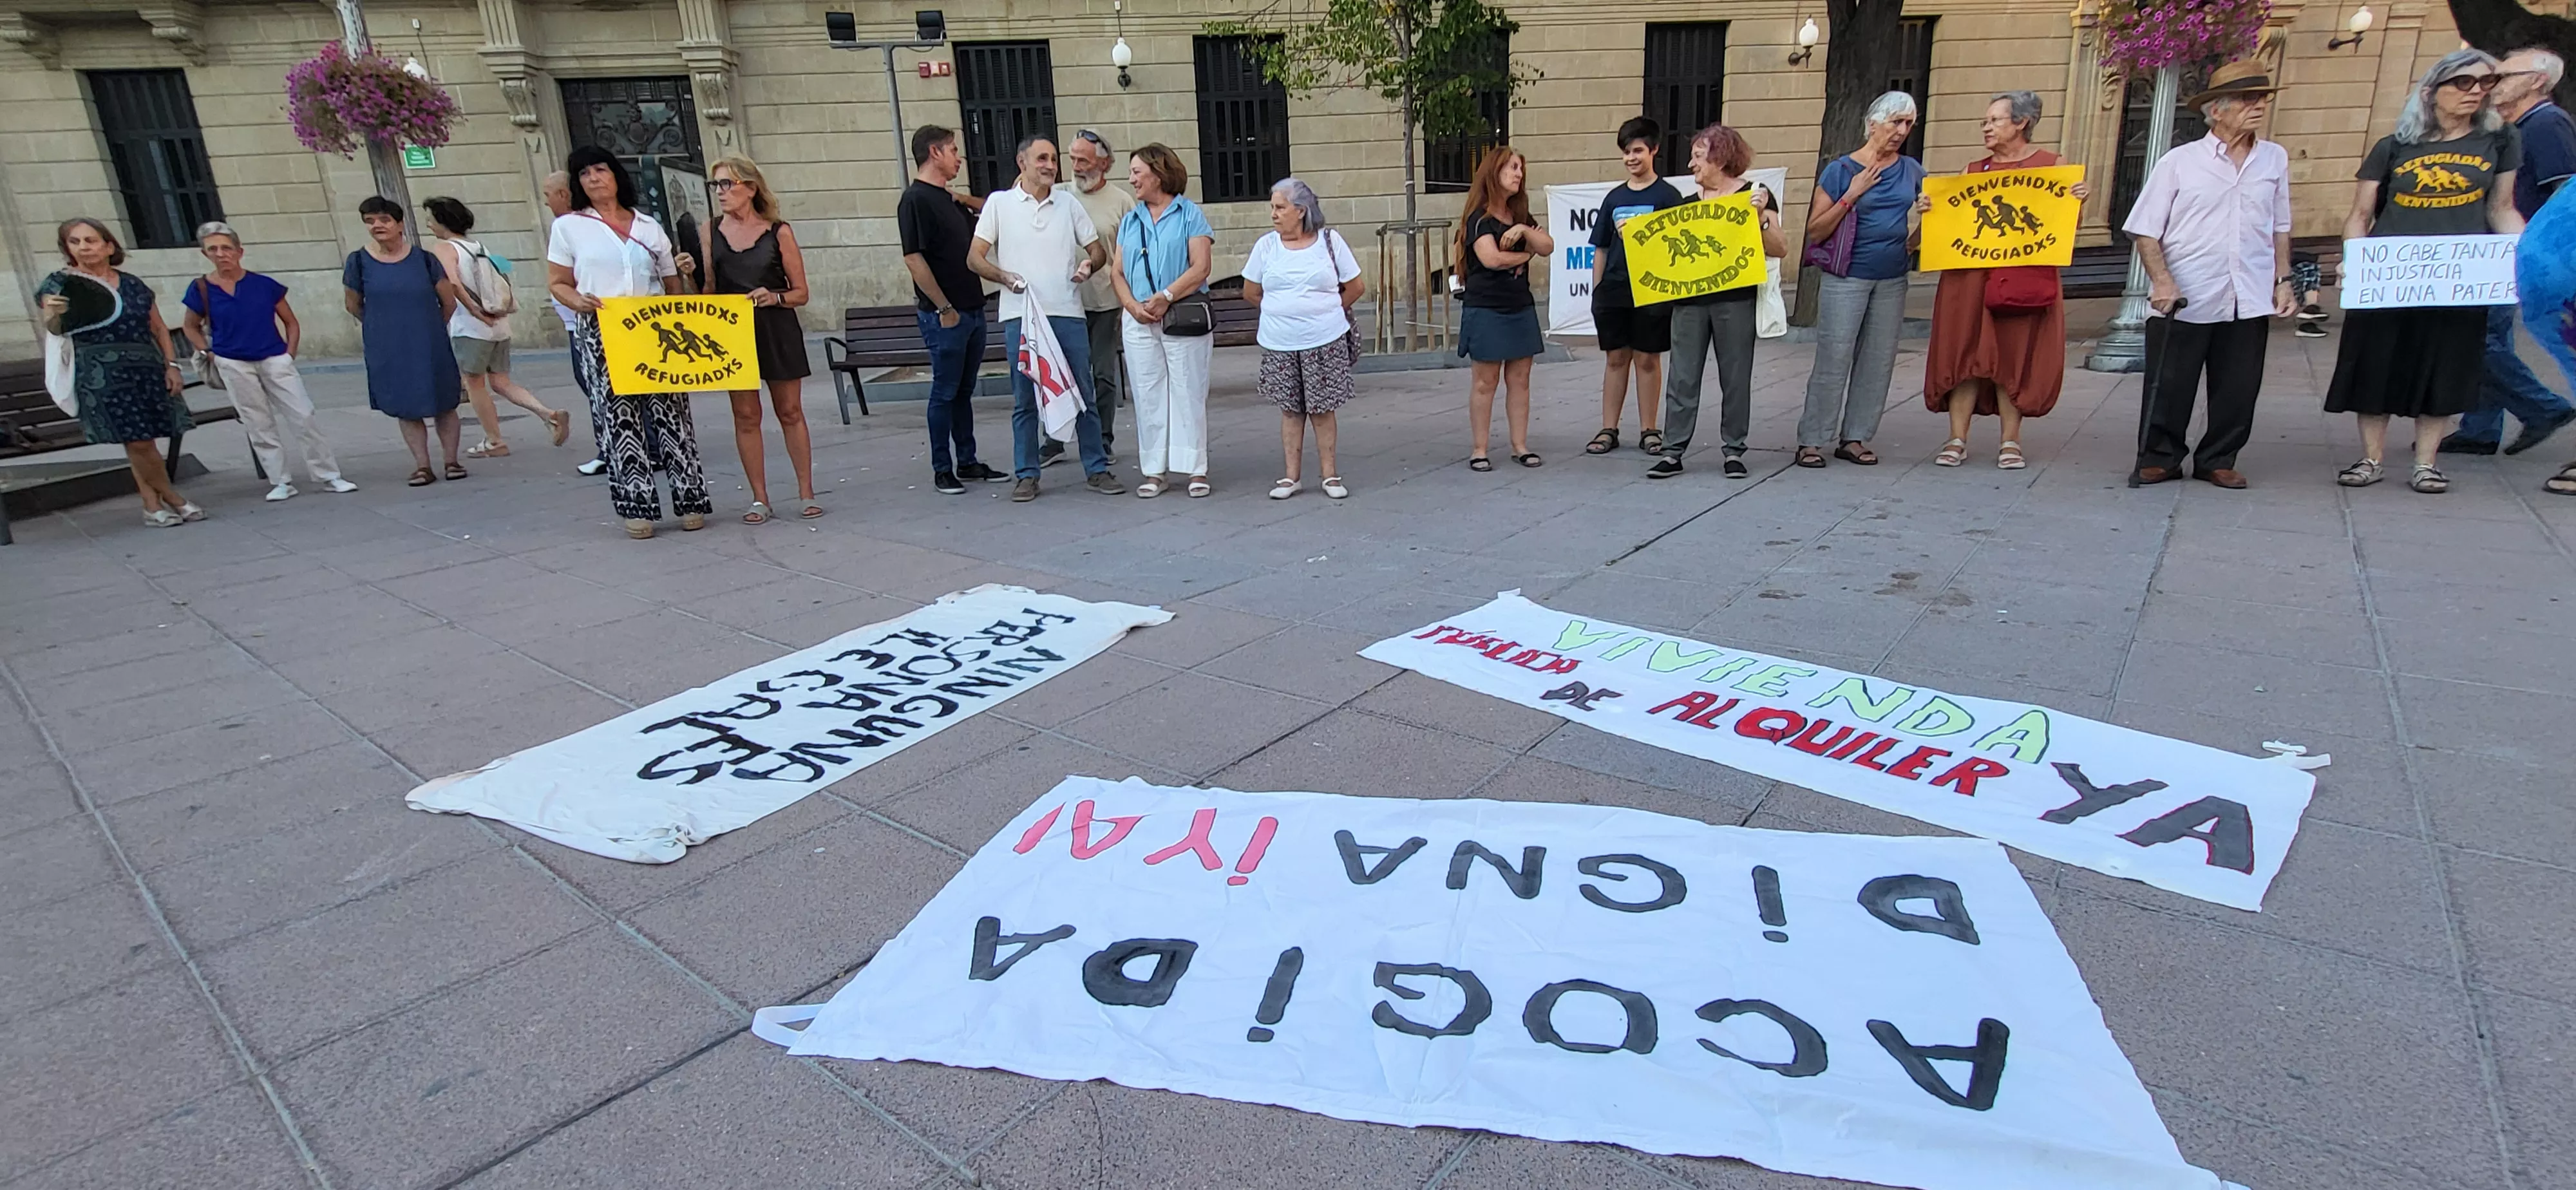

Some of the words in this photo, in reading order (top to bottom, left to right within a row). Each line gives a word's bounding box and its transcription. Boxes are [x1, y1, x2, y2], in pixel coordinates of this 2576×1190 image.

[1947, 175, 2069, 208] BIENVENIDXS
[1632, 203, 1750, 247] REFUGIADOS
[1951, 232, 2056, 261] REFUGIADXS
[2362, 244, 2389, 263] NO
[2396, 242, 2446, 262] CABE
[2450, 240, 2515, 260] TANTA
[1638, 245, 1756, 297] BIENVENIDOS
[2361, 263, 2462, 283] INJUSTICIA
[2359, 287, 2385, 305] EN
[2396, 284, 2436, 303] UNA
[621, 301, 739, 331] BIENVENIDXS
[634, 358, 743, 385] REFUGIADXS
[797, 607, 1076, 713] PERSONA
[1552, 619, 2050, 764] VIVIENDA
[732, 646, 1066, 782] NINGUNA
[1540, 681, 1622, 711] DE
[1646, 692, 2010, 797] ALQUILER
[2039, 761, 2255, 875] YA
